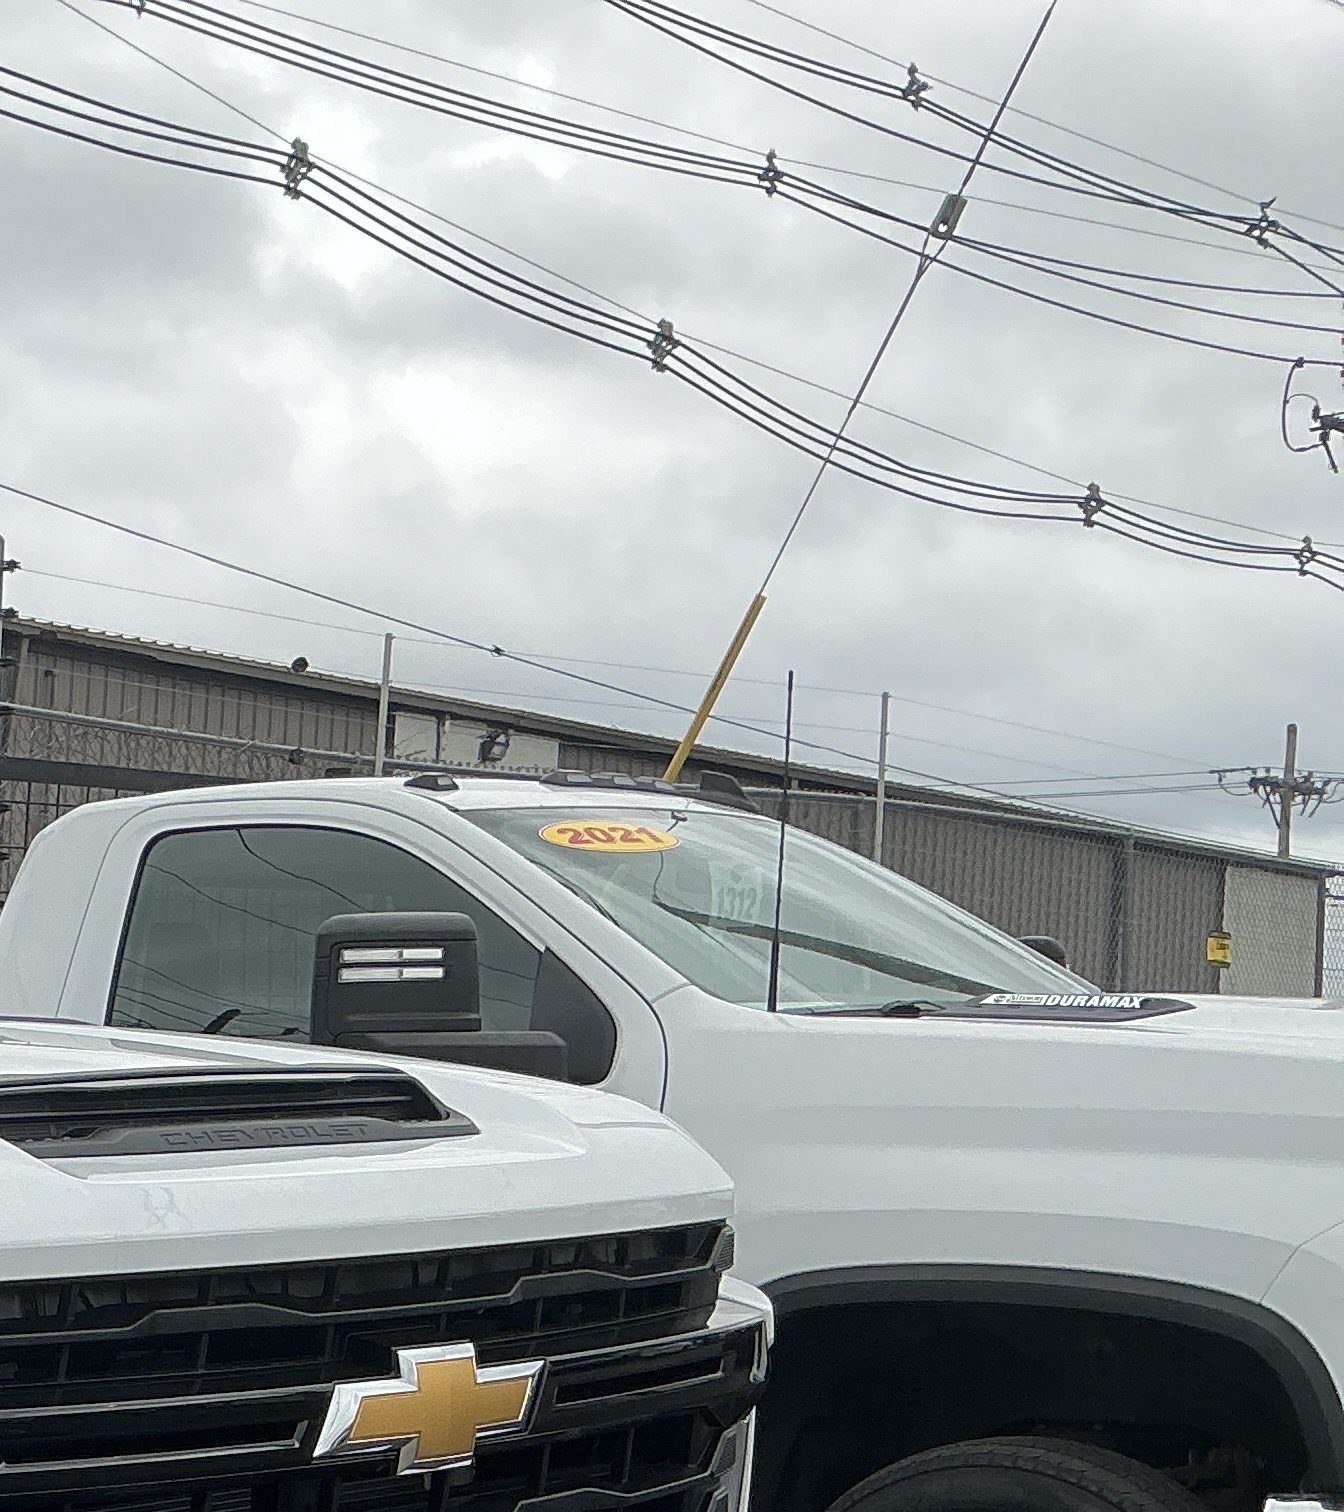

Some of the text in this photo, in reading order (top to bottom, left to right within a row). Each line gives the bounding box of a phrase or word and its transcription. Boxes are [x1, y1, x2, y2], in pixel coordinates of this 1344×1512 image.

[556, 826, 664, 845] 2021
[1045, 995, 1146, 1009] DURAMAX
[159, 1123, 370, 1147] CHEVROLET
